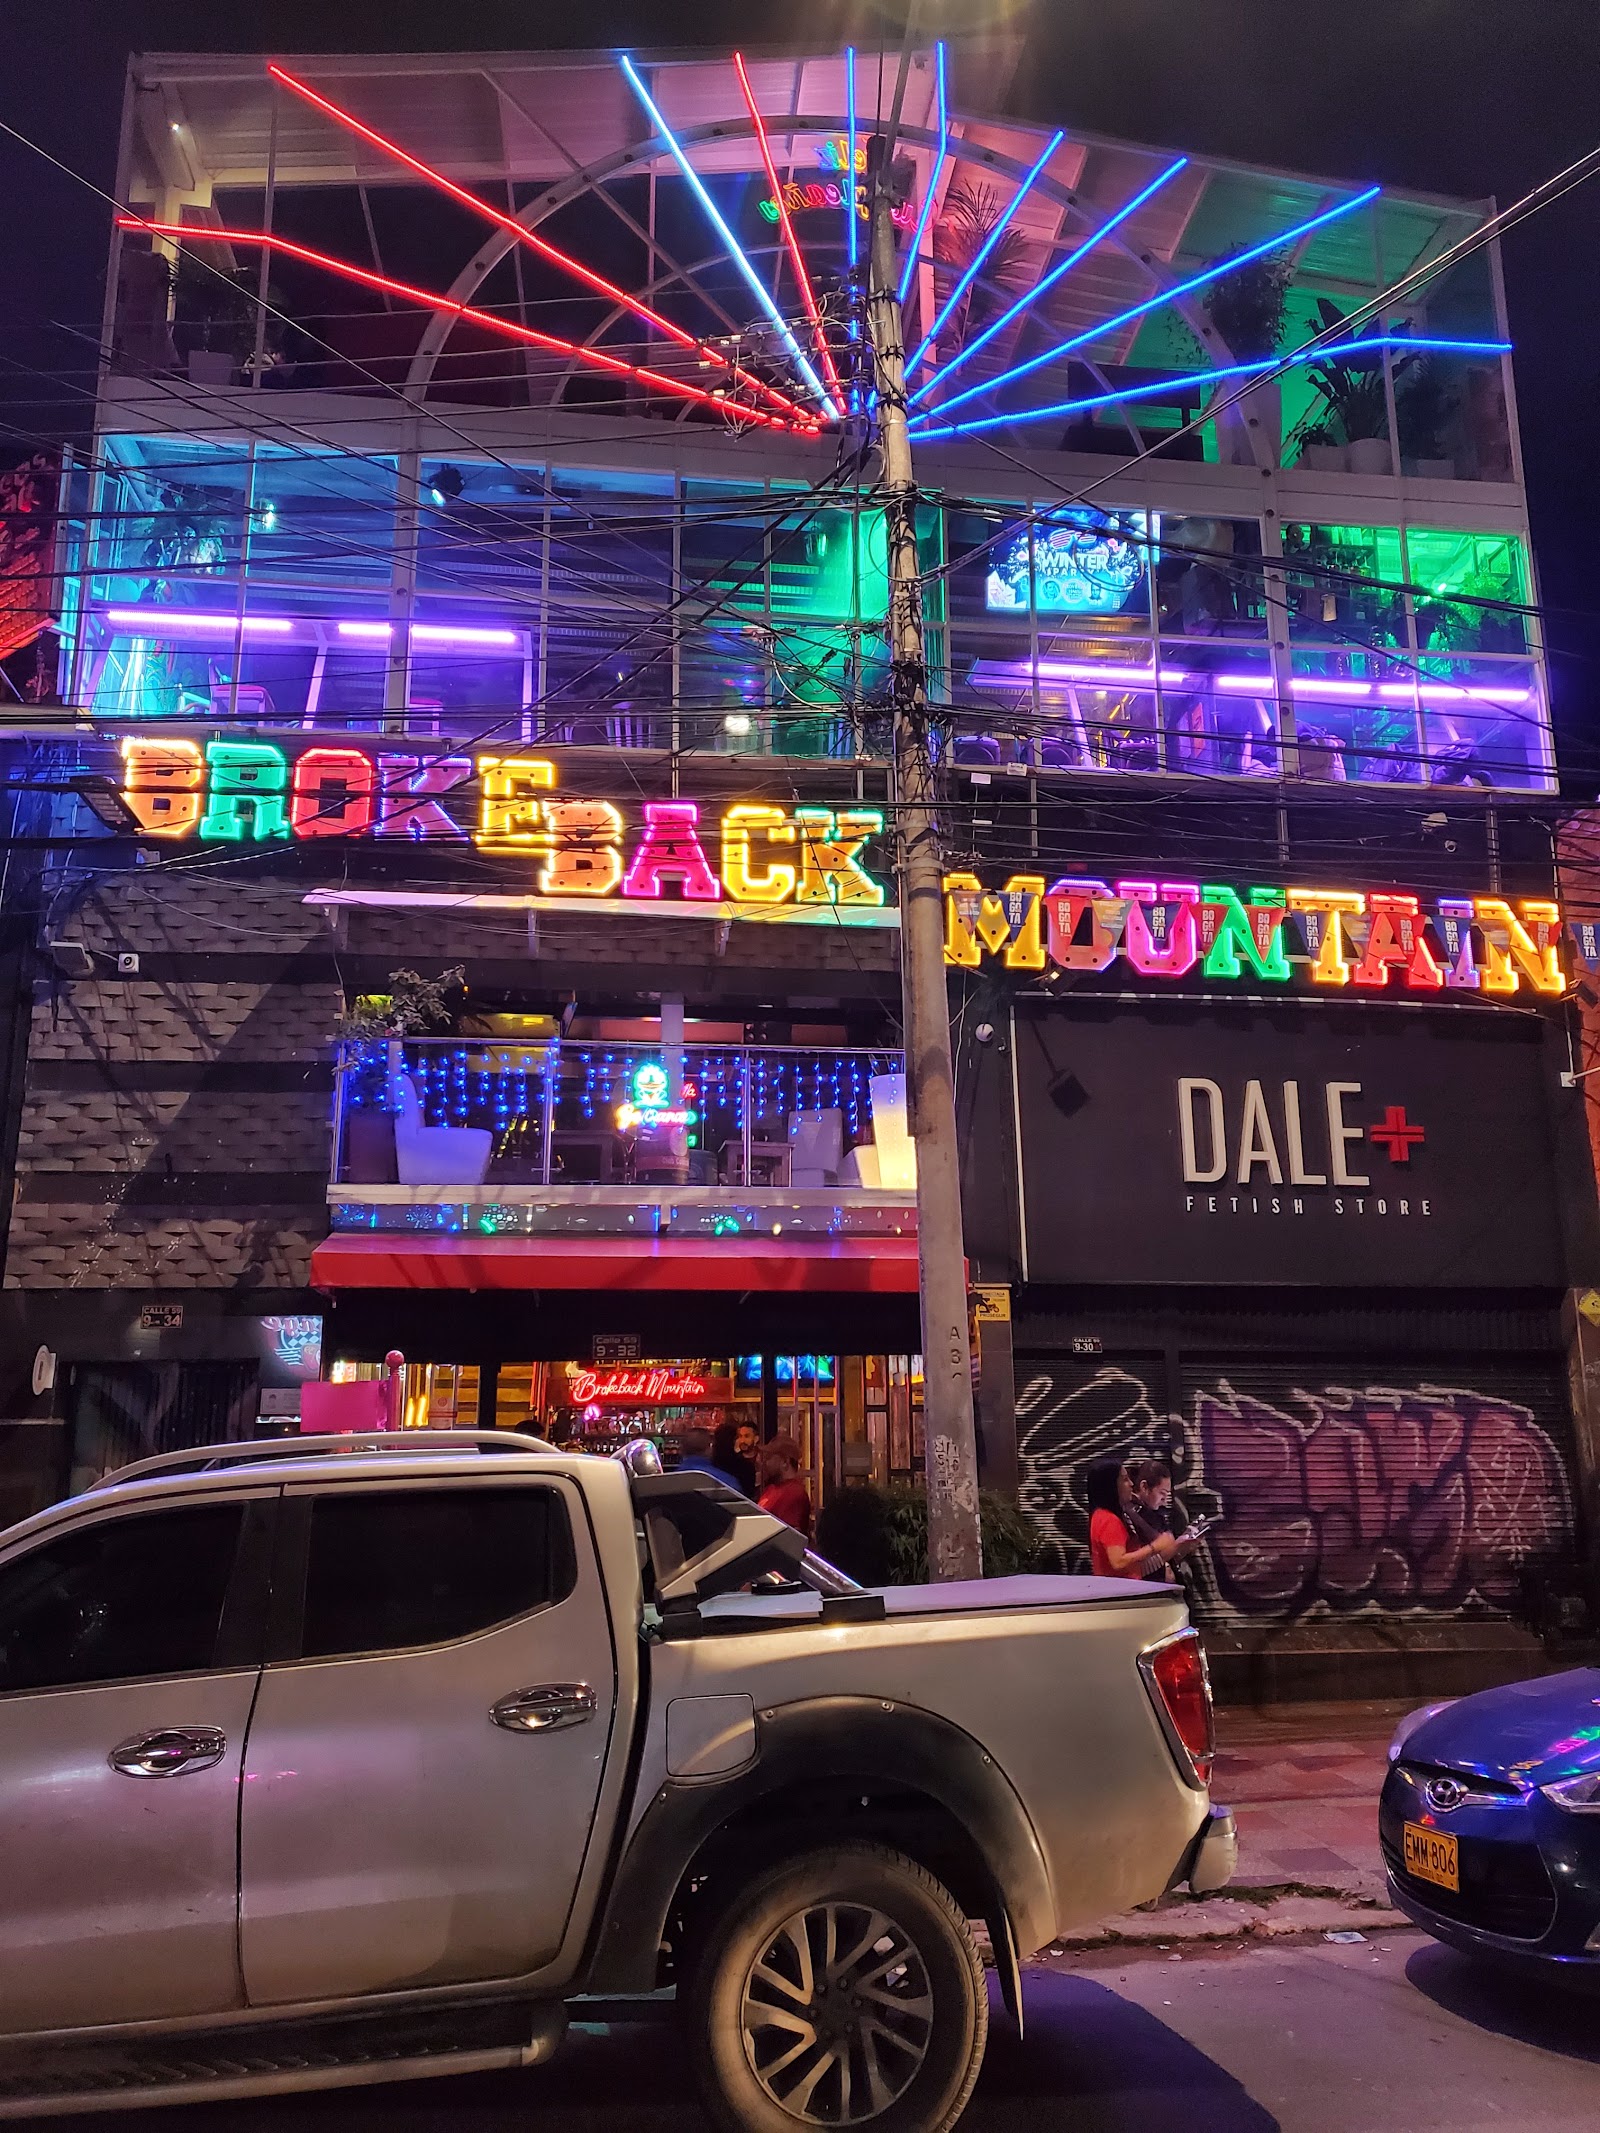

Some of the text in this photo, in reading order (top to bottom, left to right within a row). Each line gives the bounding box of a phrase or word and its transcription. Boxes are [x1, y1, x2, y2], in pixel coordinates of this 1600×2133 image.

[1041, 551, 1109, 569] WINTER
[119, 737, 555, 854] BROKE
[537, 799, 886, 907] BACK
[942, 871, 1567, 993] MOUNTAIN
[1186, 1196, 1432, 1217] FETISH STORE
[572, 1369, 705, 1402] Brokeback Mountain
